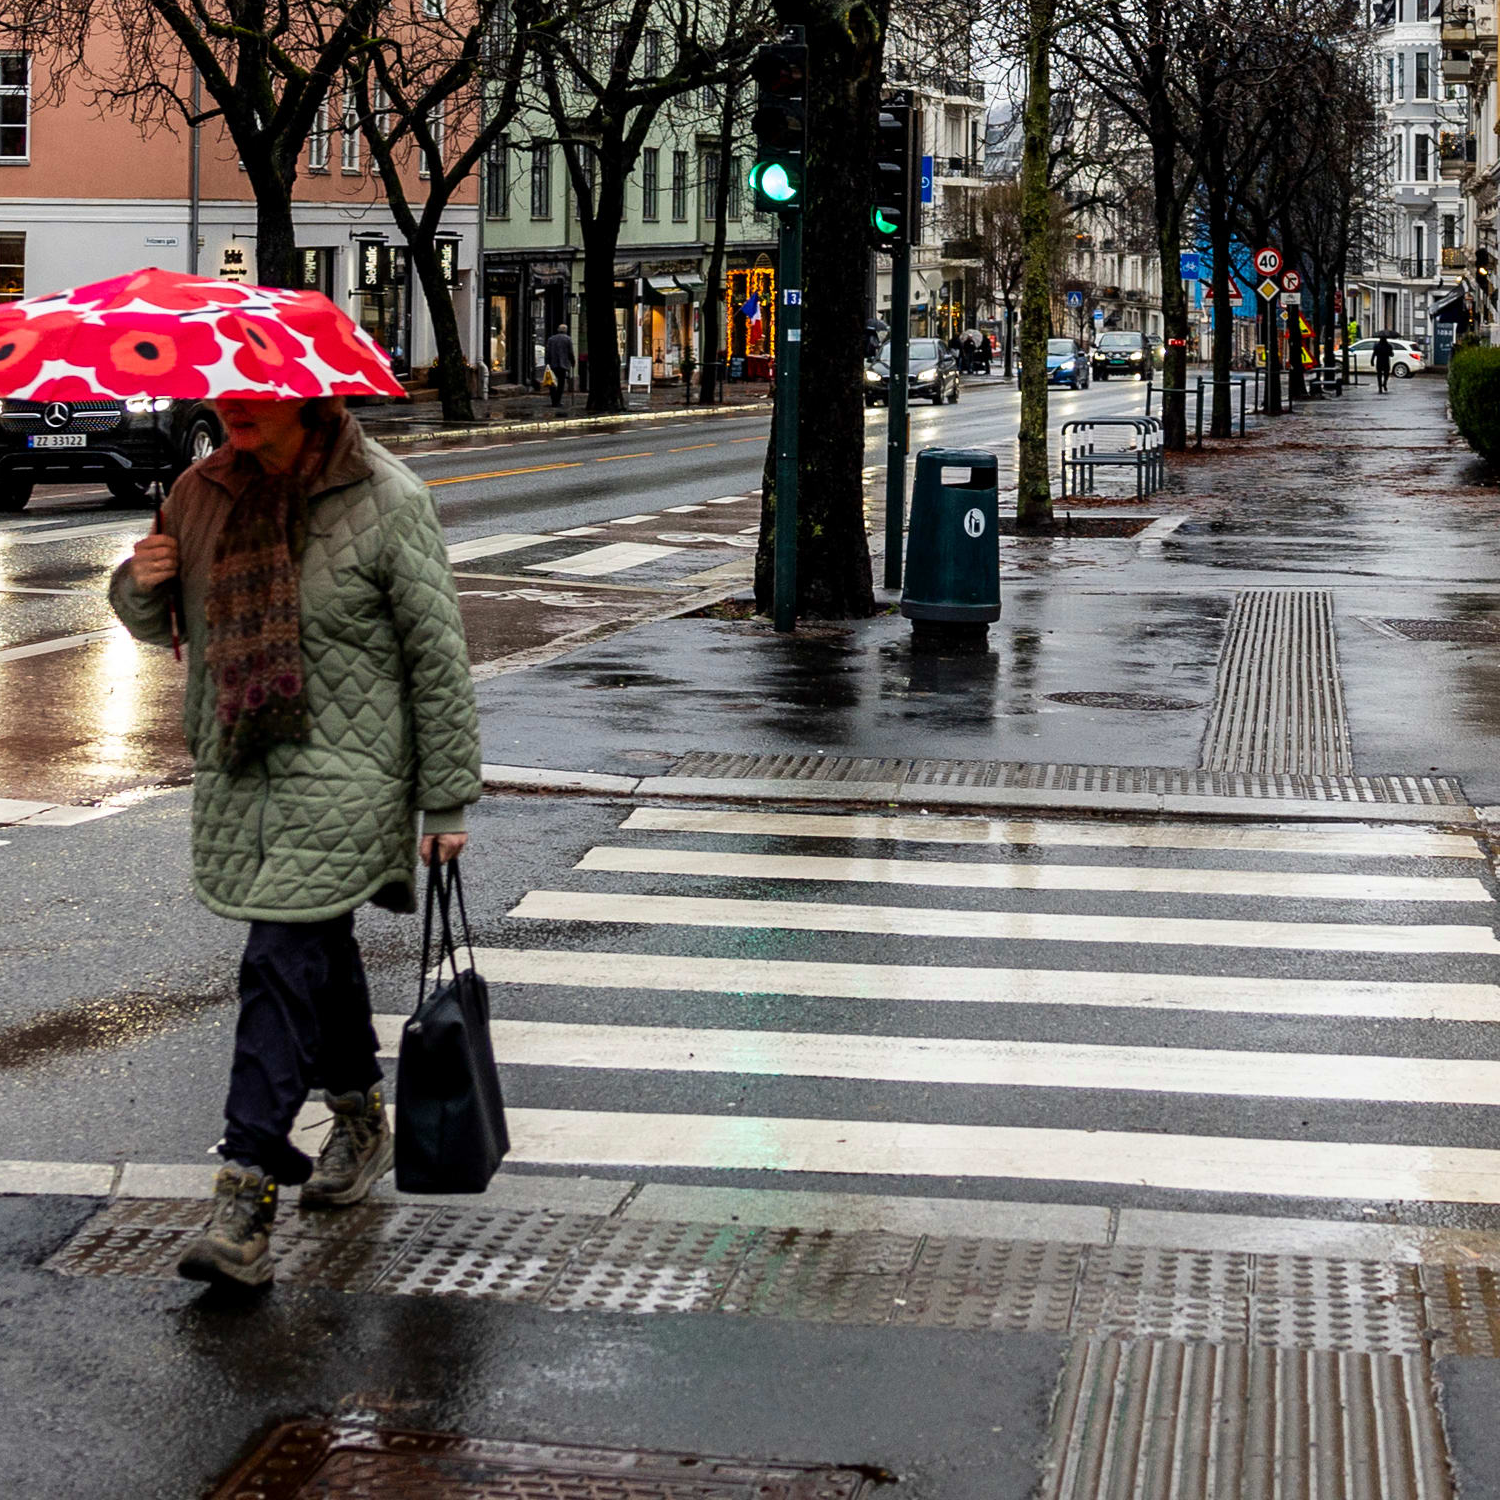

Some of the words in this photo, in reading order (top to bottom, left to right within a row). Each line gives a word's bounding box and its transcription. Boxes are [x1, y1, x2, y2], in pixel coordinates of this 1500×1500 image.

[1259, 254, 1278, 269] 40
[36, 435, 48, 447] ZZ
[51, 435, 83, 447] 33122
